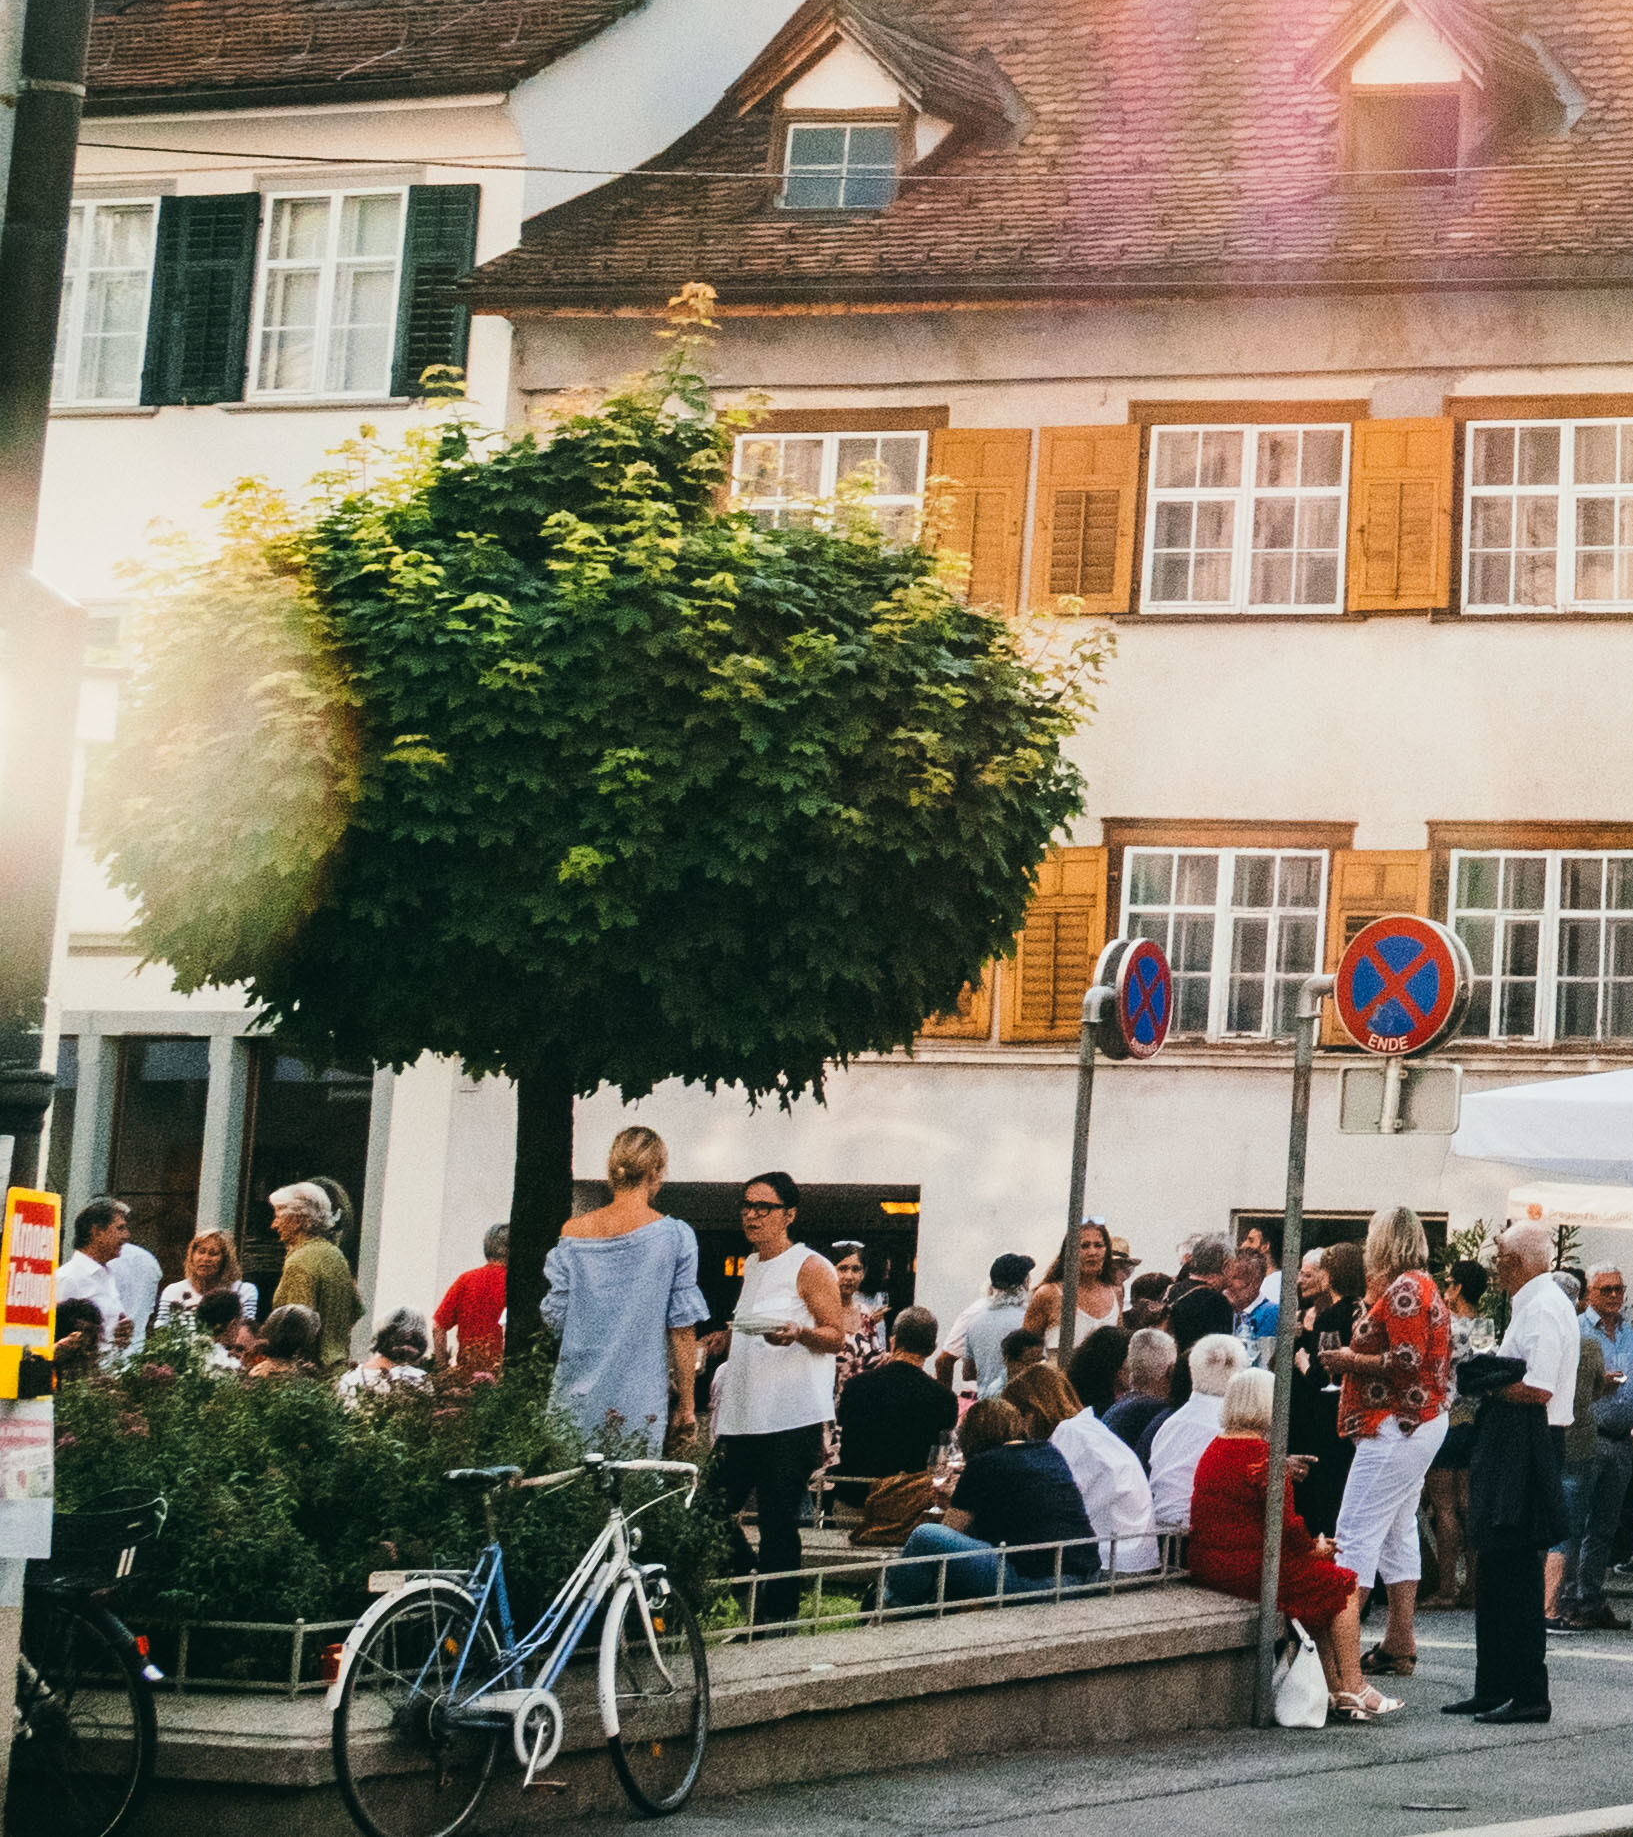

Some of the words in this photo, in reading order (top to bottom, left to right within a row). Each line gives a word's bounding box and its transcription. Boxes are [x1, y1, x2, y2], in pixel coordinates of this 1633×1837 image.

[1367, 1033, 1409, 1052] ENDE
[9, 1212, 56, 1261] Kronen
[6, 1260, 52, 1314] Zeitung
